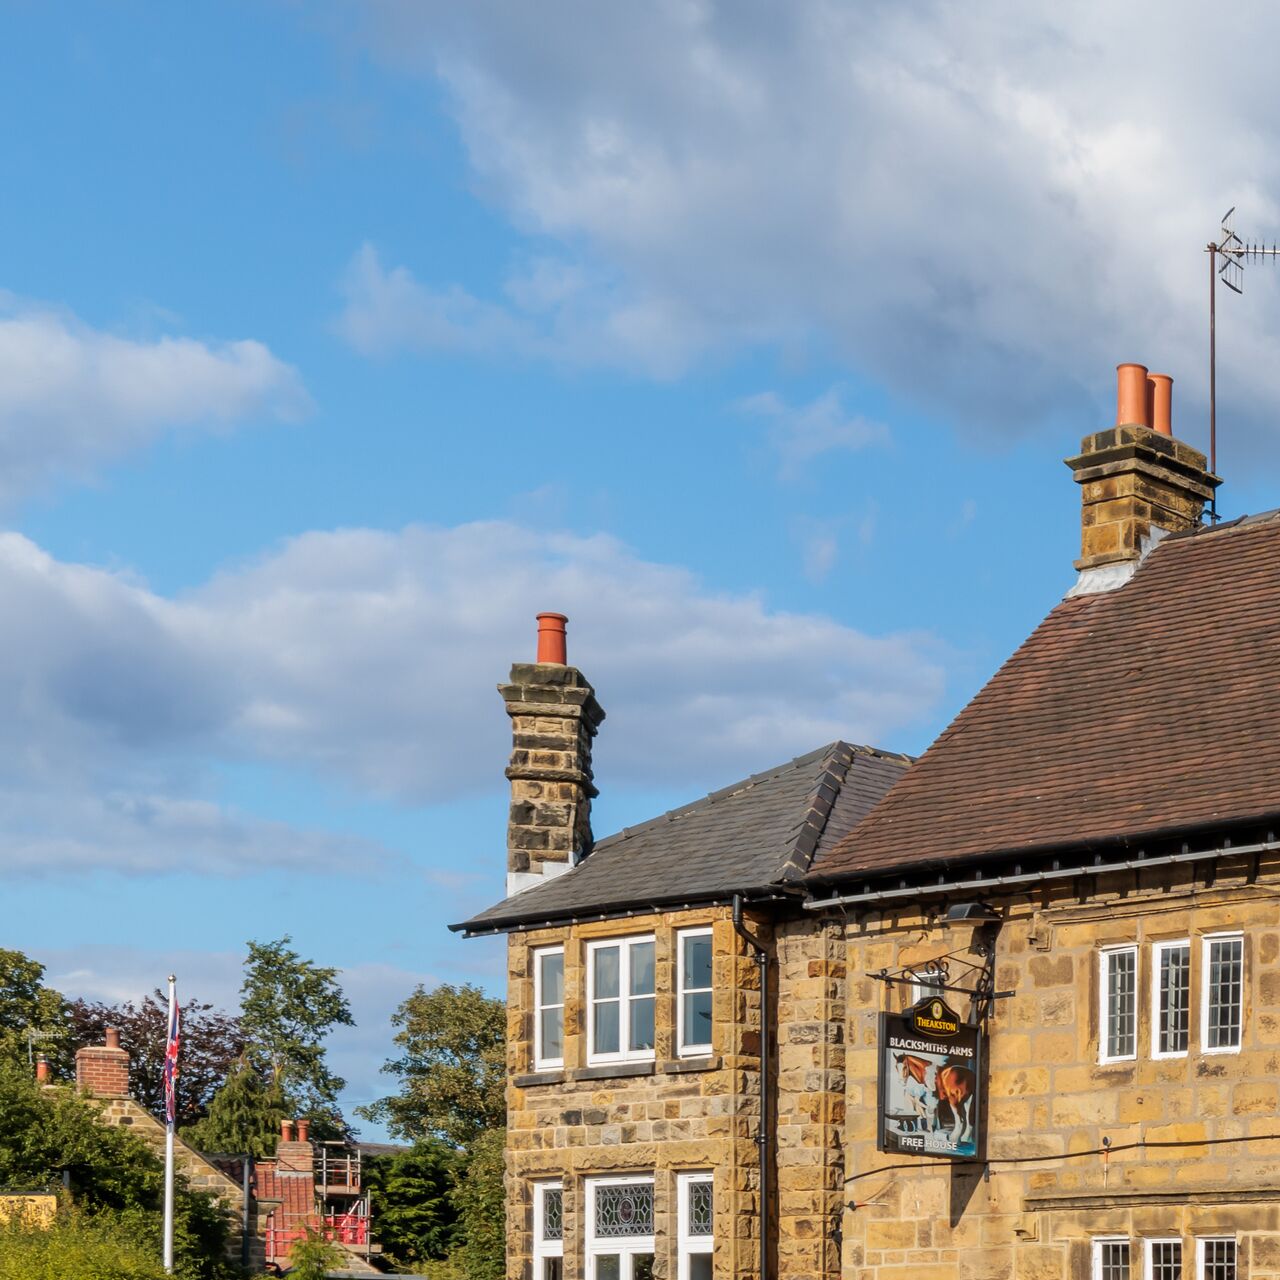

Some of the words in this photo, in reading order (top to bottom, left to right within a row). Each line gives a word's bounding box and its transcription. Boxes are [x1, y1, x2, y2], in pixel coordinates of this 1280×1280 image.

[917, 1017, 956, 1031] THEAKSTON
[890, 1037, 948, 1053] BLACKSMITHS
[949, 1046, 973, 1057] ARMS
[901, 1137, 924, 1147] FREE
[925, 1140, 958, 1150] HOUSE
